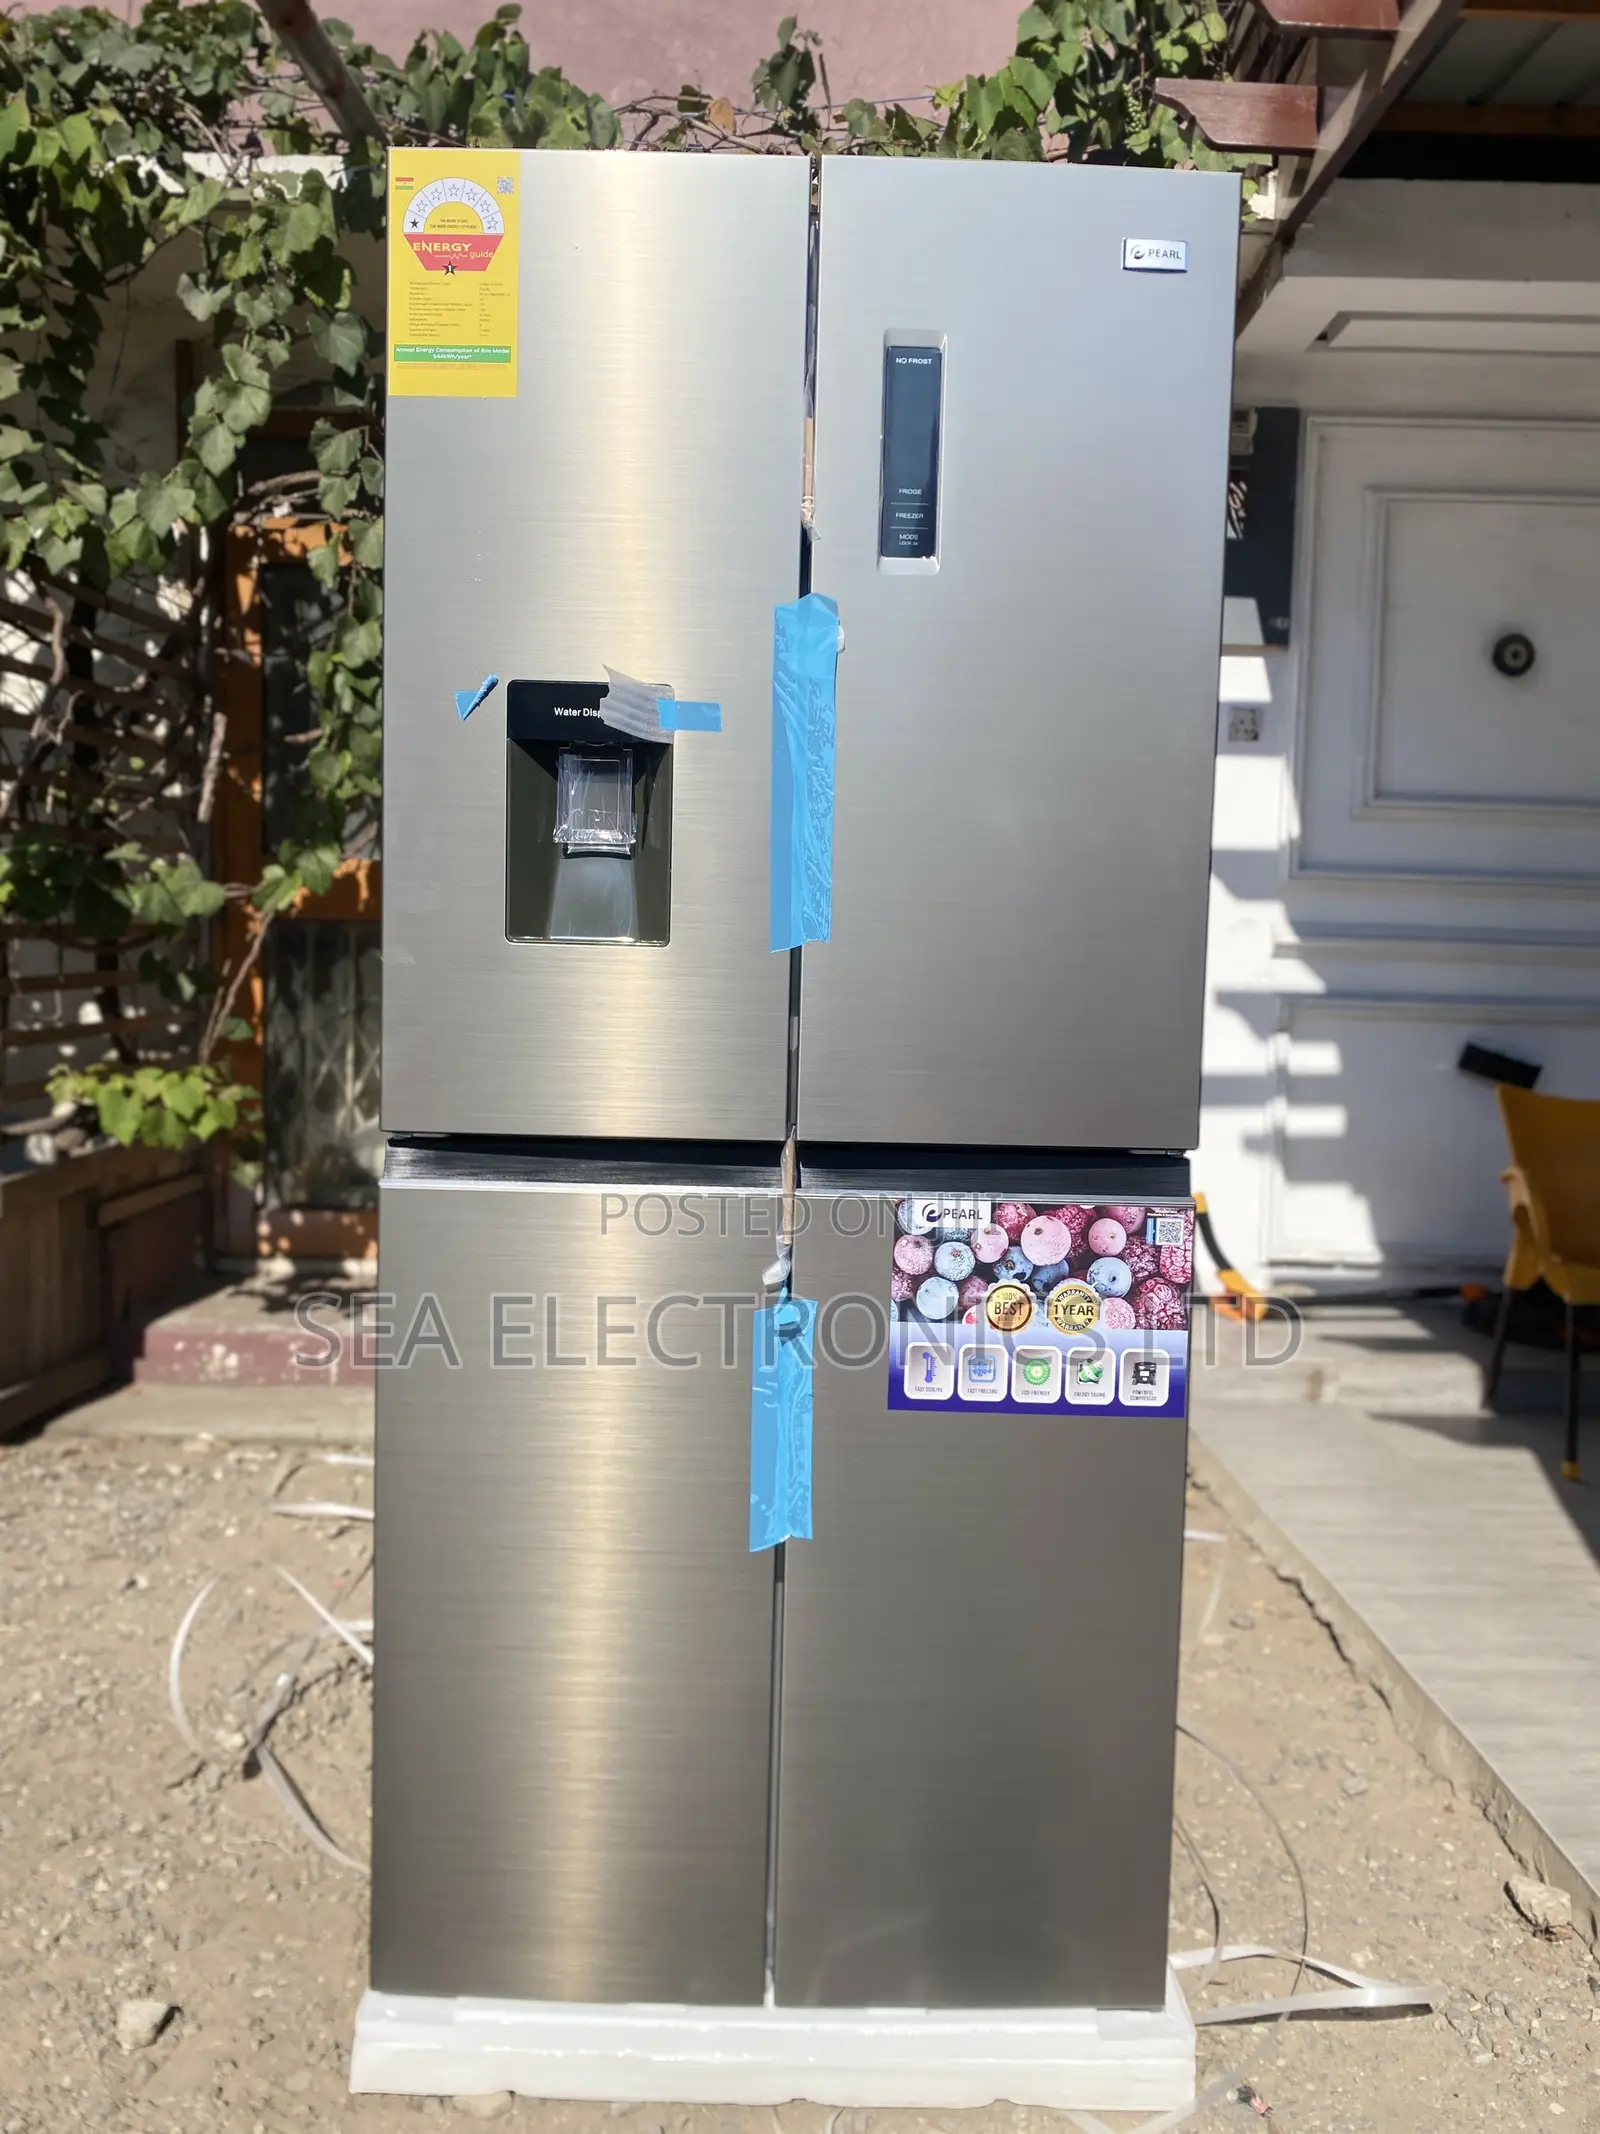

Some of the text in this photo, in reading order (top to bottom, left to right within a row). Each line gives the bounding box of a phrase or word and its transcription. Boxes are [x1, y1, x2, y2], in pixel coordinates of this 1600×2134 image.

[413, 240, 472, 254] ENERGY
[470, 250, 494, 259] guide
[1148, 248, 1183, 260] PEARL
[447, 264, 452, 272] 1
[908, 357, 933, 365] FROST
[554, 707, 582, 717] Water
[943, 1207, 983, 1220] PEARL
[1057, 1288, 1093, 1303] WARRANTY
[994, 1301, 1024, 1316] BEST
[1053, 1304, 1094, 1316] 1 YEAR
[1056, 1317, 1092, 1332] WARRANTY
